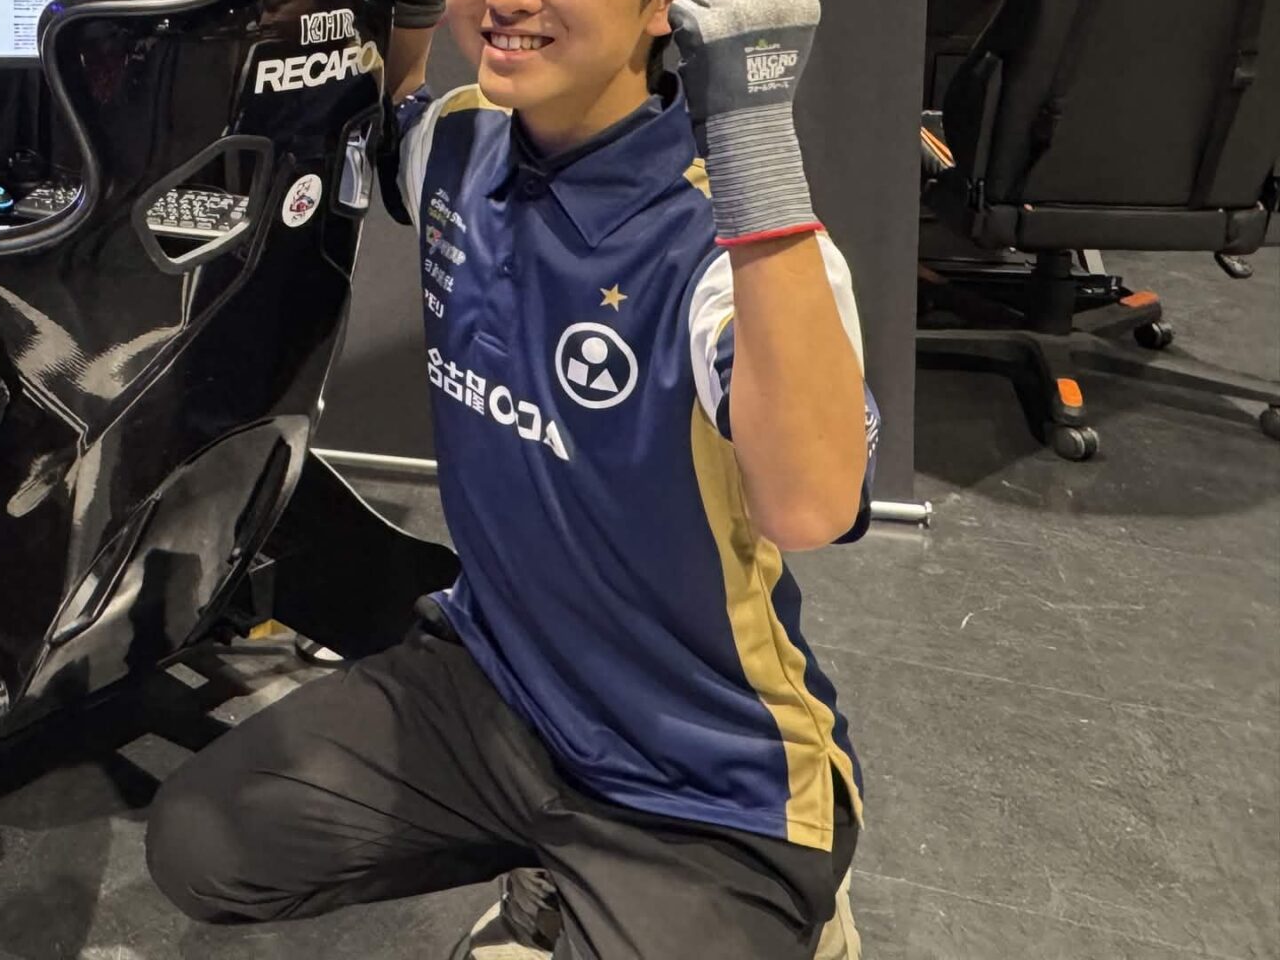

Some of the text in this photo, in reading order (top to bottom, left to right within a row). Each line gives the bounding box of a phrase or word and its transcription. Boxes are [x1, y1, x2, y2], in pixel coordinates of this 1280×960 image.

[254, 41, 378, 95] RECARO
[427, 347, 570, 461] 名古屋OJA
